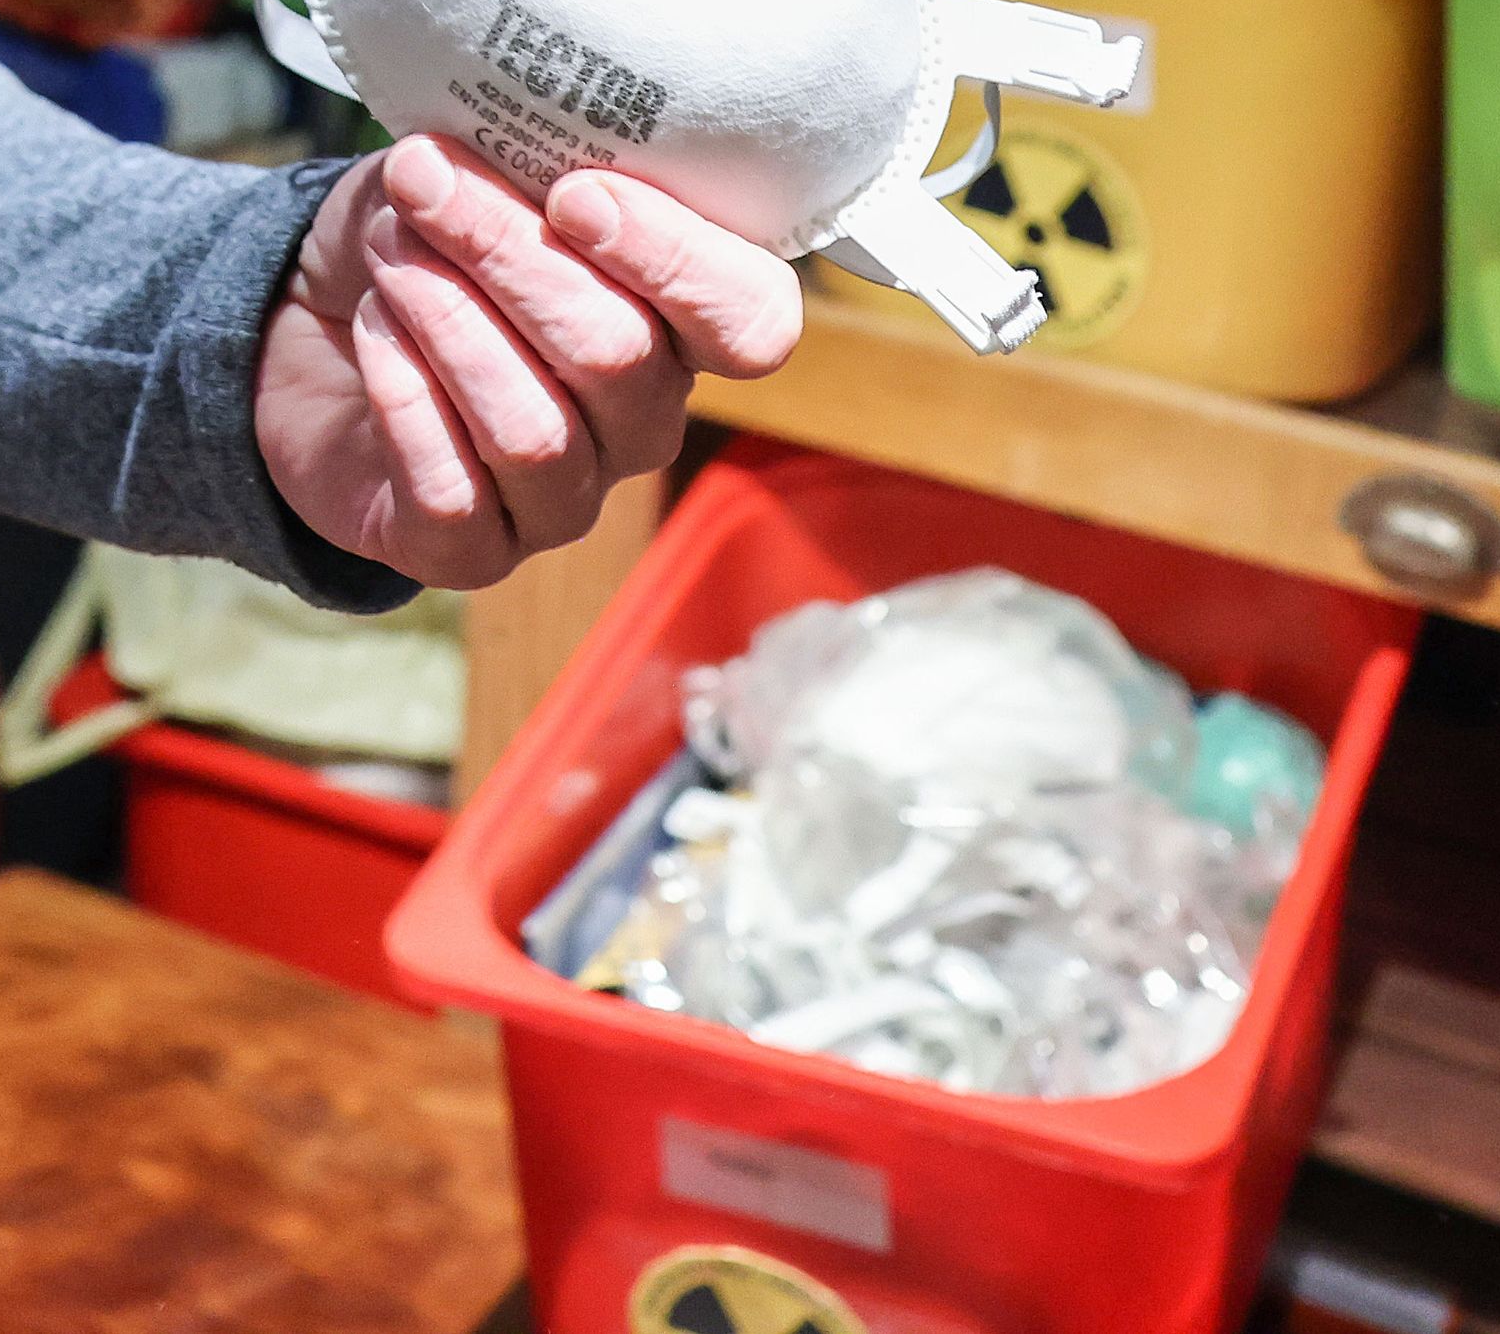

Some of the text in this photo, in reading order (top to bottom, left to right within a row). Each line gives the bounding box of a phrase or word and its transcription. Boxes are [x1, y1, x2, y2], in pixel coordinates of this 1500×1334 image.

[477, 80, 616, 167] 4236 FFP3 NR
